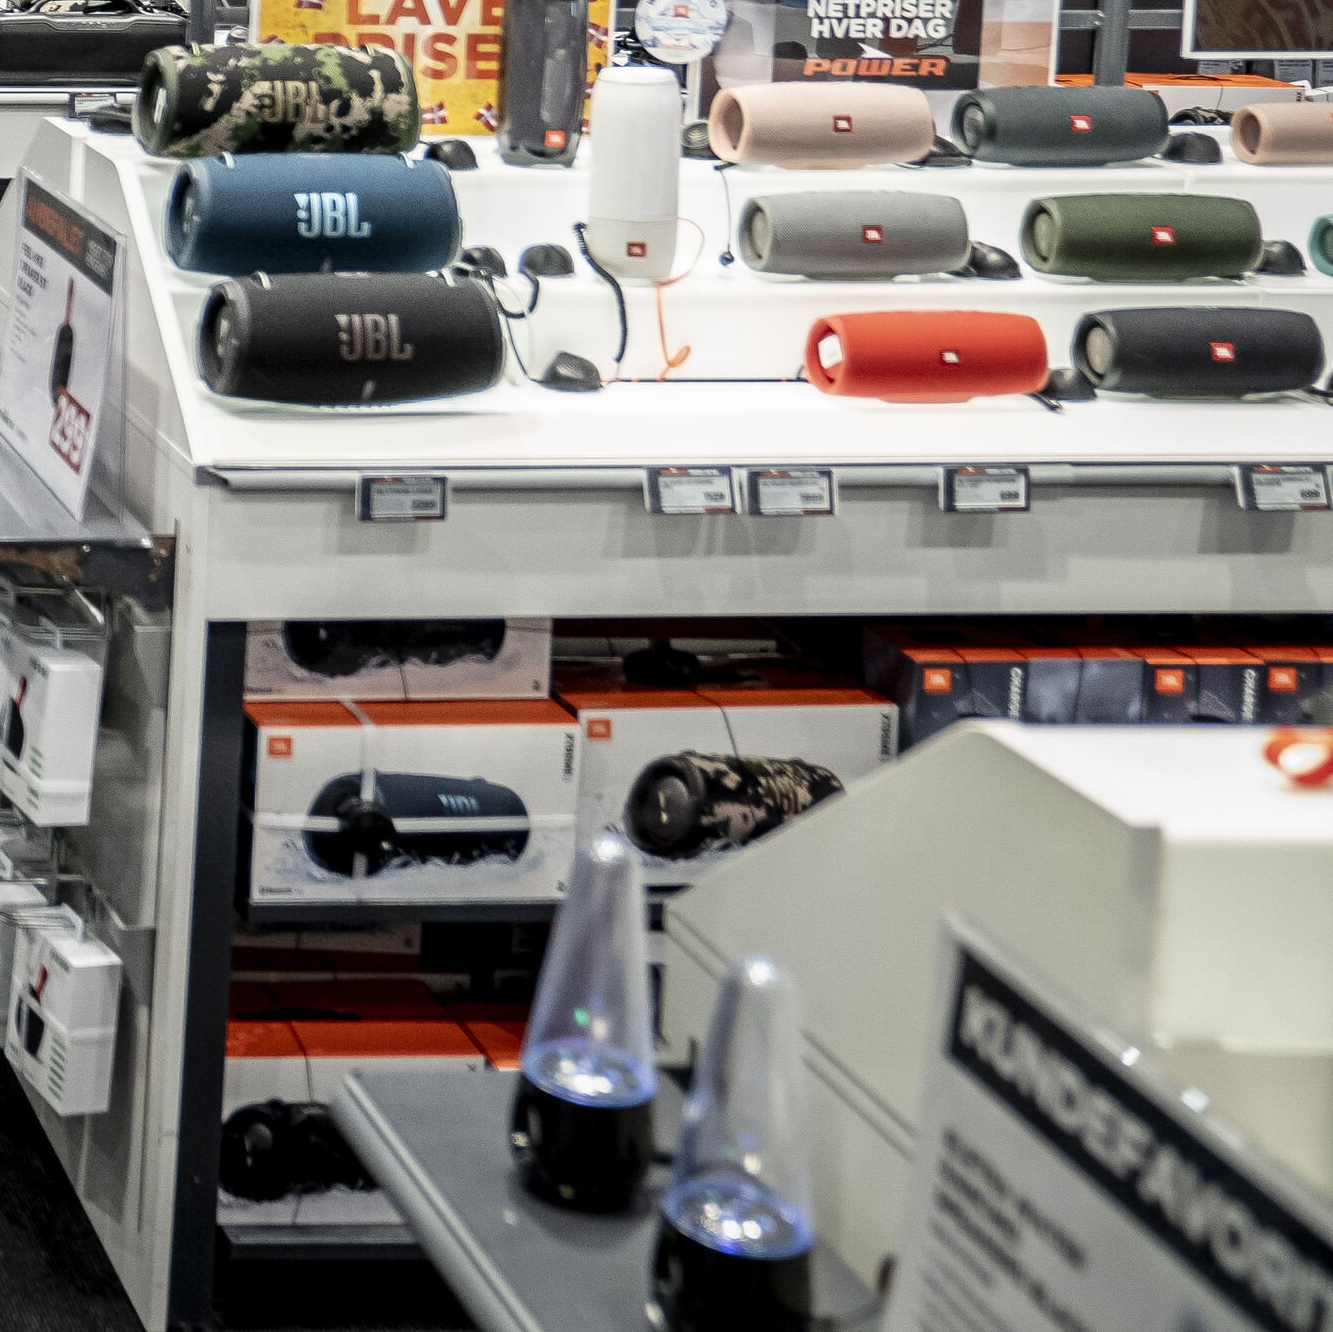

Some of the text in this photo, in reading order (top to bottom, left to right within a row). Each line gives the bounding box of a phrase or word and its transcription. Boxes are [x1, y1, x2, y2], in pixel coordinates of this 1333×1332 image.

[810, 18, 947, 39] HVER DAG
[802, 56, 950, 78] POWER
[254, 80, 327, 125] JBL
[293, 192, 371, 239] JBL
[335, 313, 414, 361] JBL
